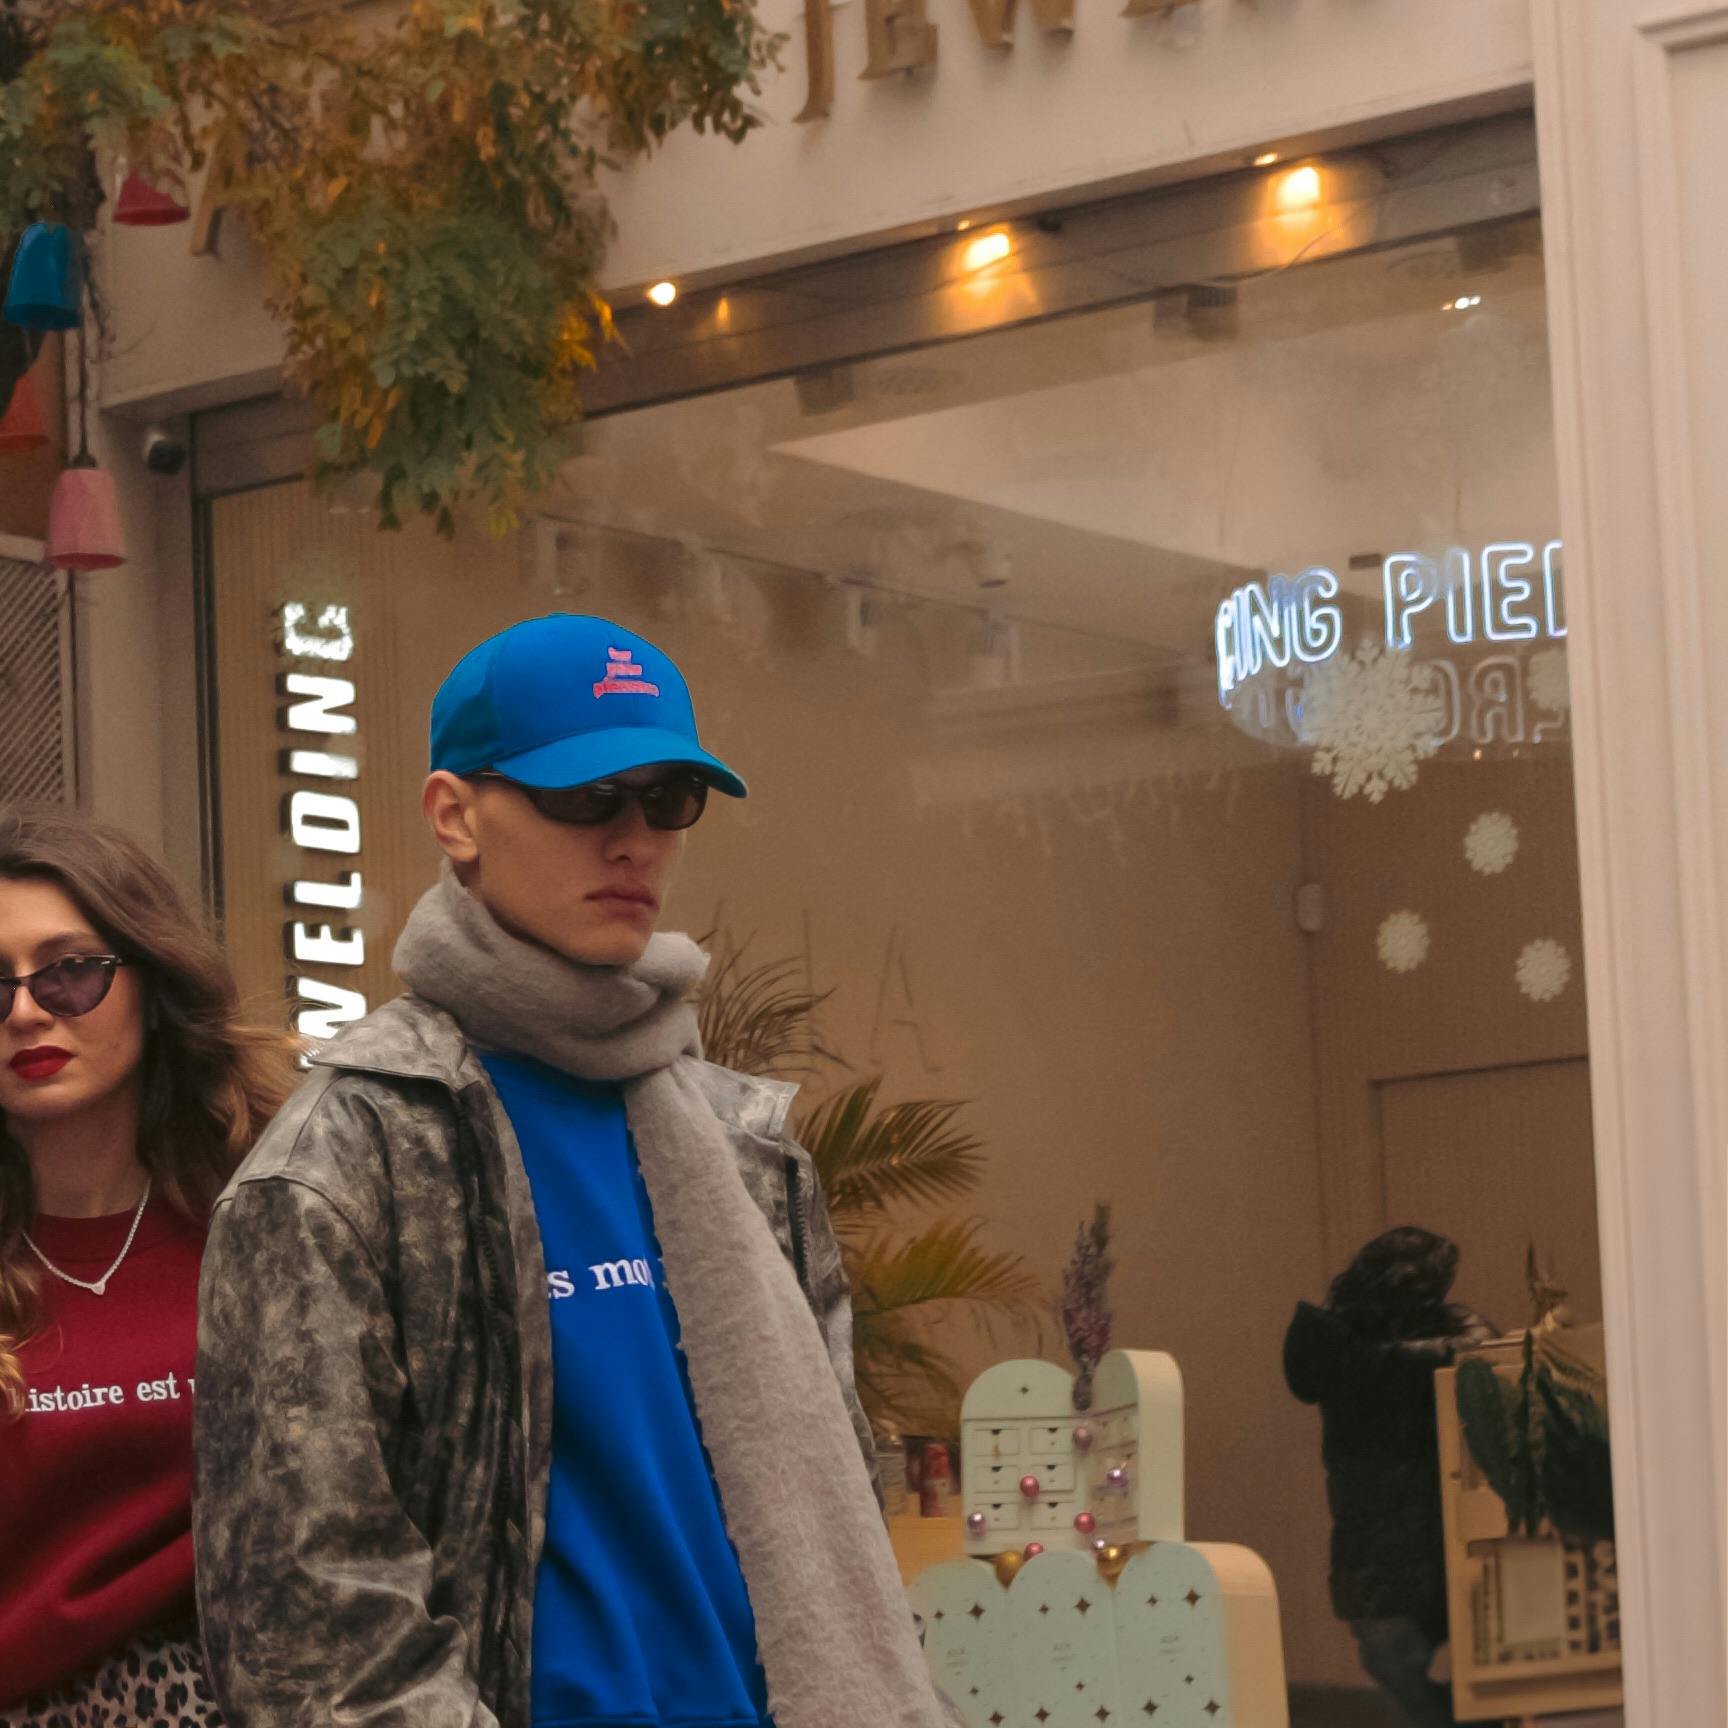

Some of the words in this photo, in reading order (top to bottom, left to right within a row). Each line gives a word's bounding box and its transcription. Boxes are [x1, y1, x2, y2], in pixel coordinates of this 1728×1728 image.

[547, 1268, 576, 1300] s
[7, 1382, 124, 1414] istoire
[136, 1371, 181, 1402] est
